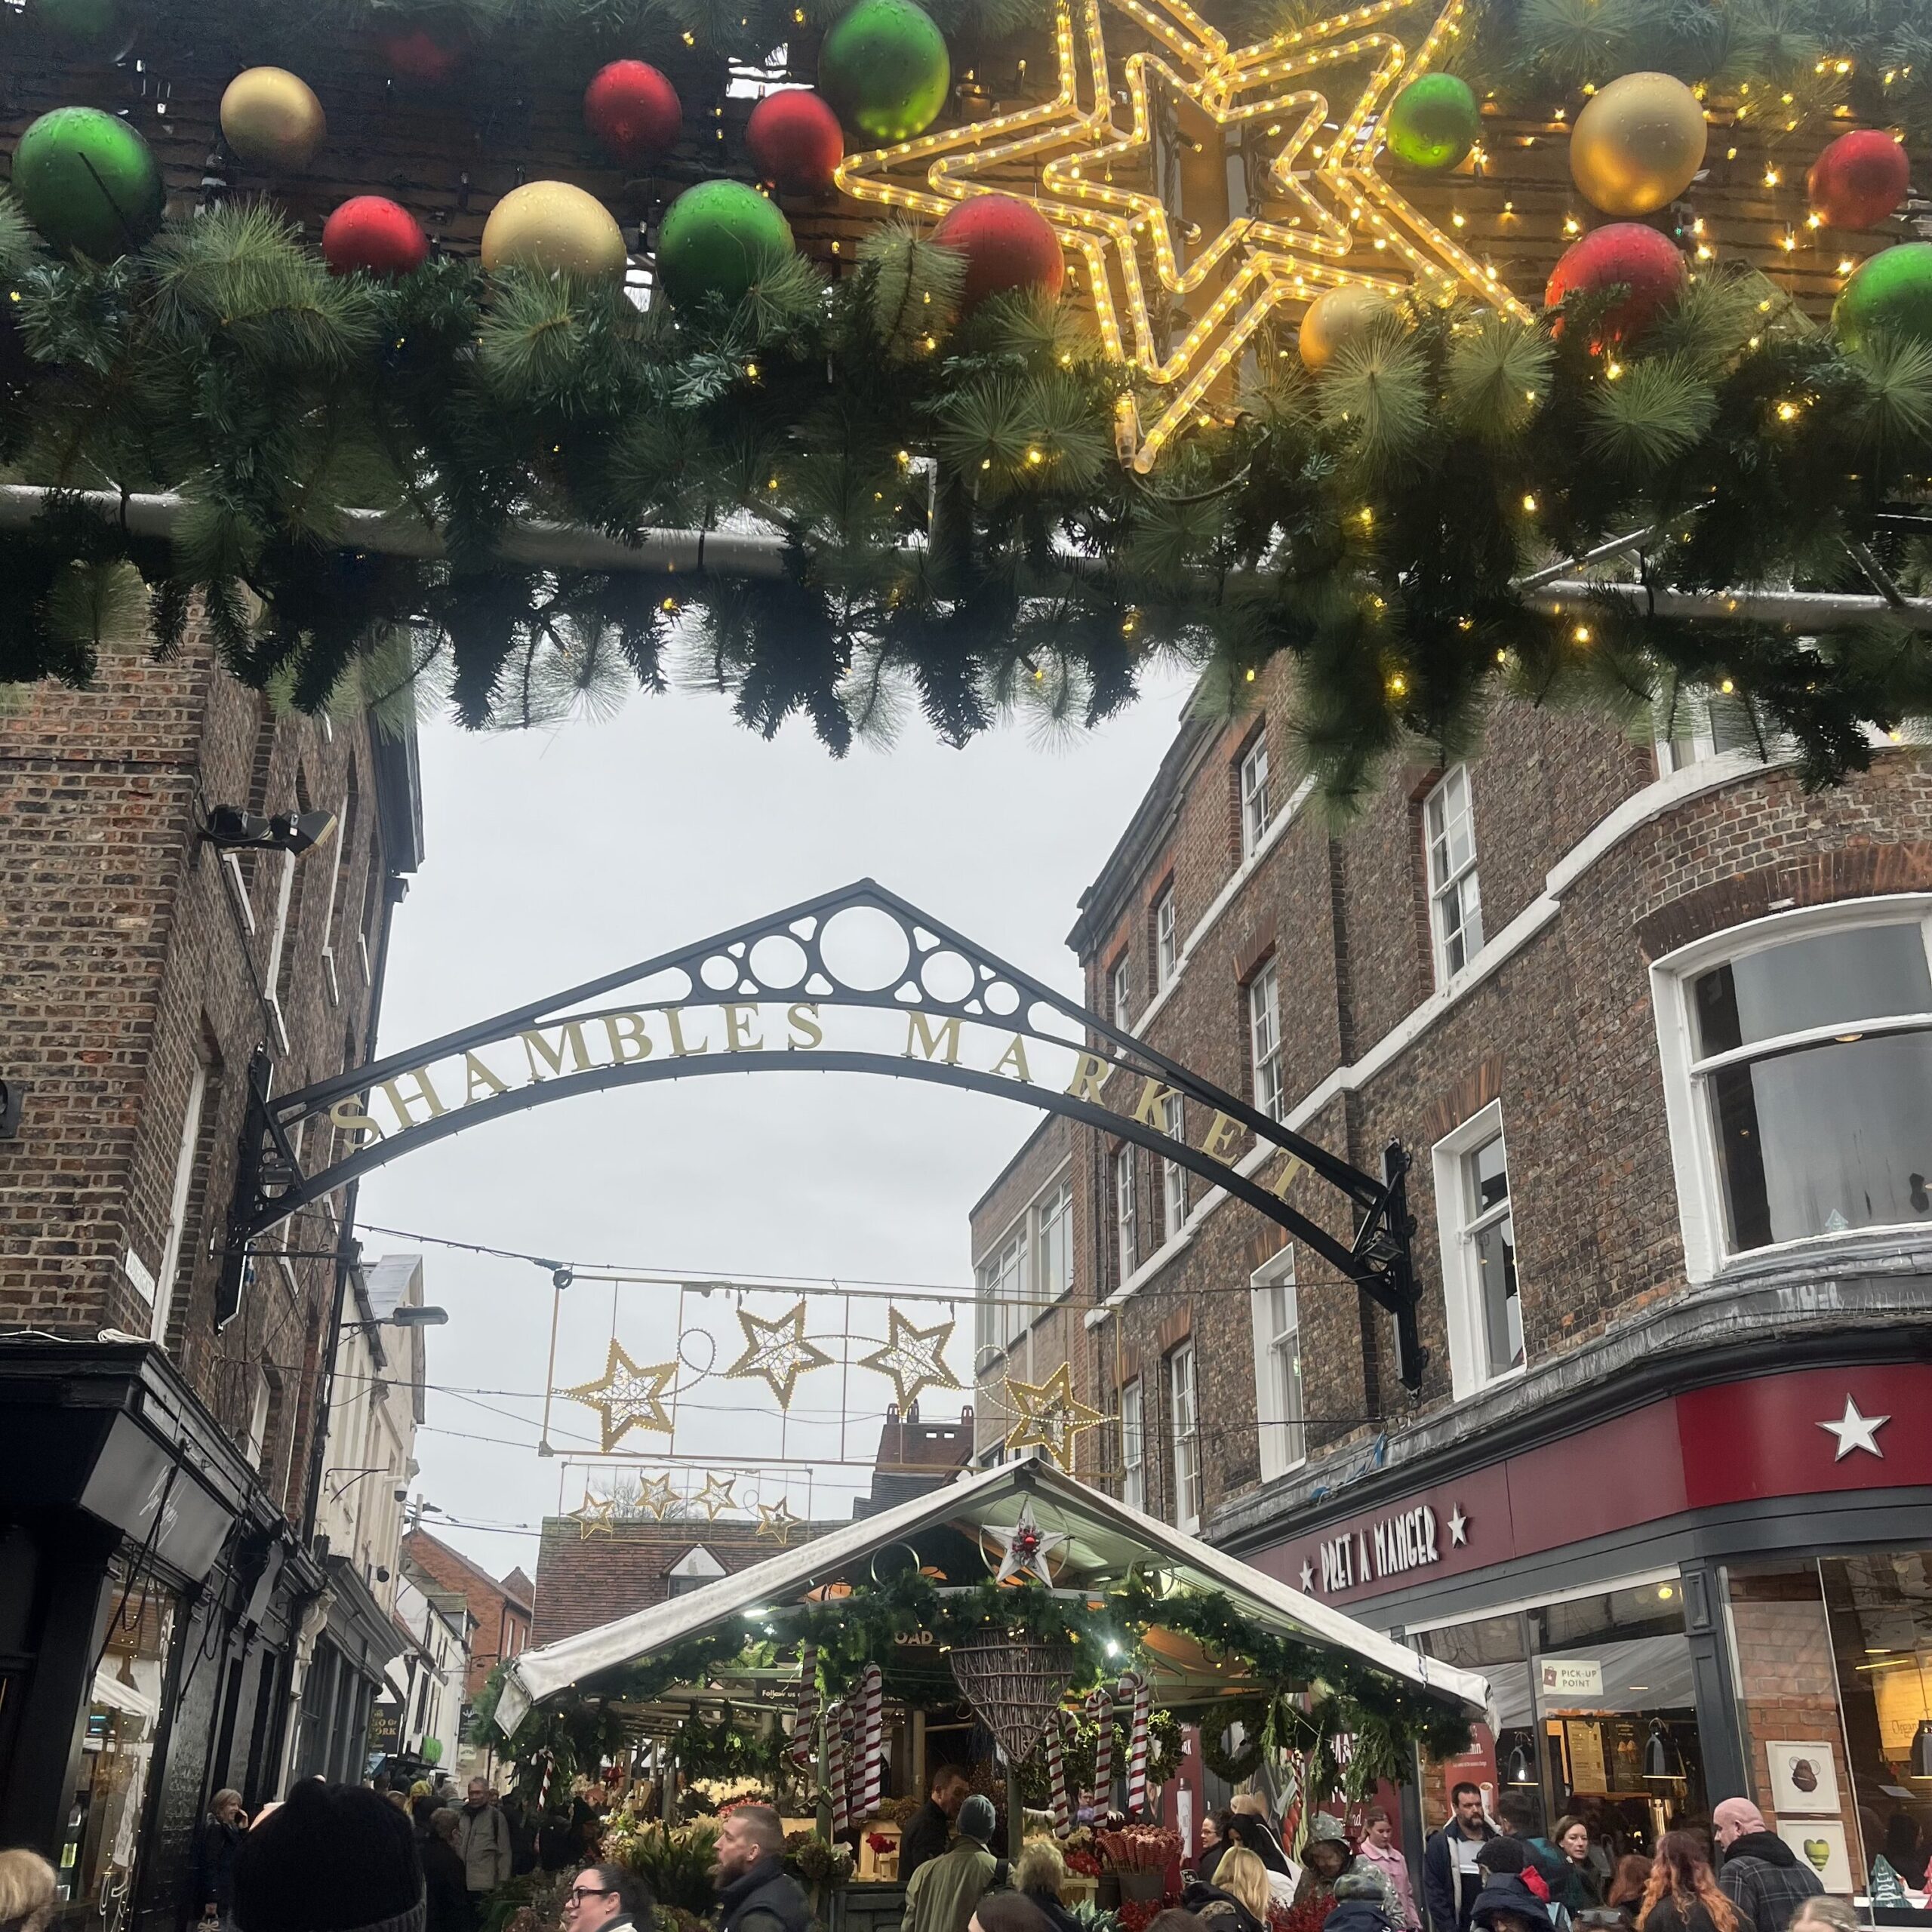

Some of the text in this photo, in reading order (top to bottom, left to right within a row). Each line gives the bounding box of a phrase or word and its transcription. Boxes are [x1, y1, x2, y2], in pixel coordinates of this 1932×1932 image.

[330, 1002, 1316, 1202] SHAMBLES MARKET
[1320, 1505, 1440, 1593] PRET A MANGER
[894, 1630, 934, 1644] OAD
[1561, 1669, 1597, 1678] PICK-UP
[1562, 1679, 1590, 1687] POINT
[1875, 1872, 1902, 1901] PRET
